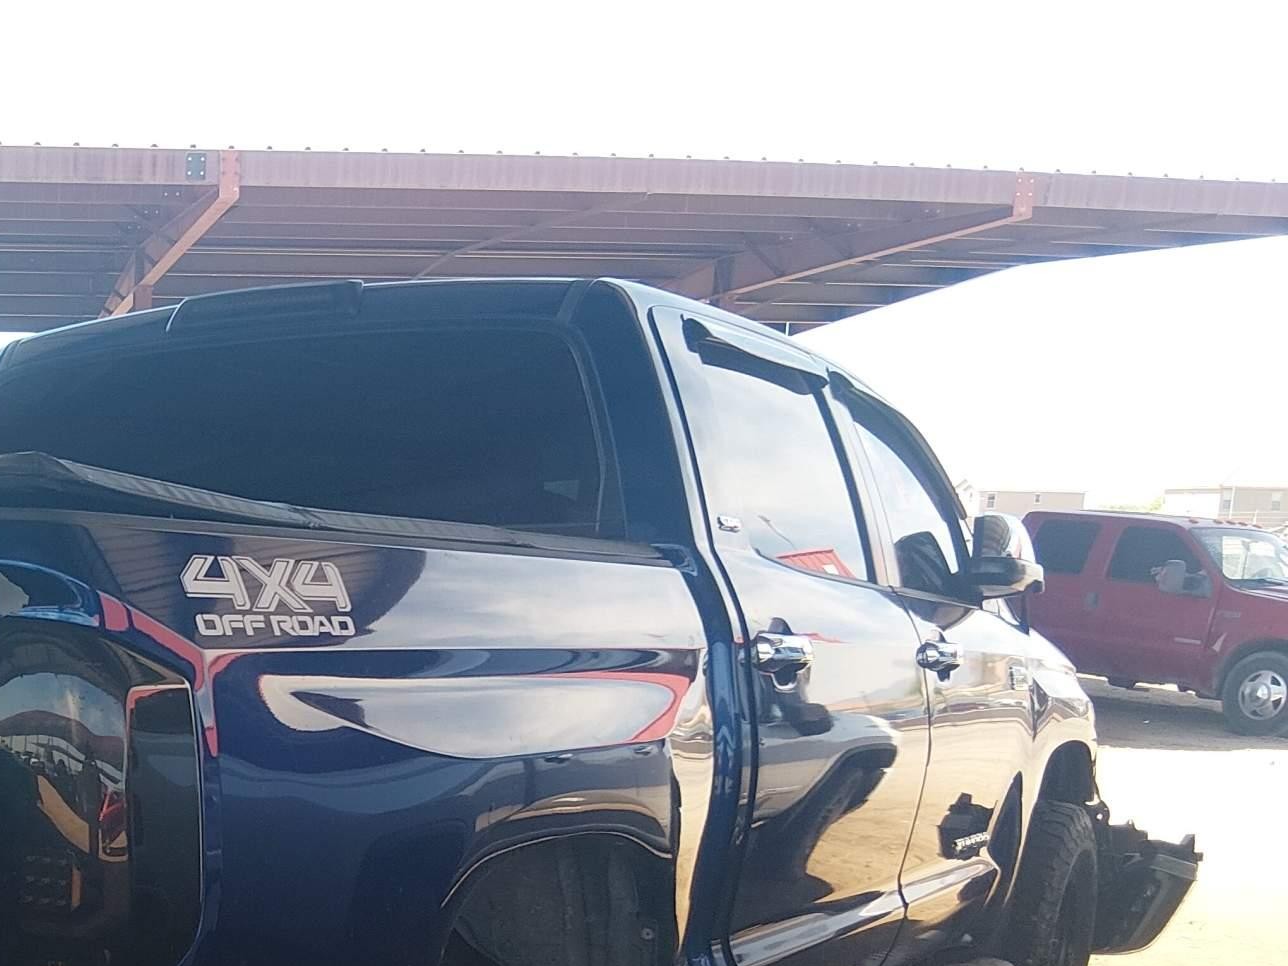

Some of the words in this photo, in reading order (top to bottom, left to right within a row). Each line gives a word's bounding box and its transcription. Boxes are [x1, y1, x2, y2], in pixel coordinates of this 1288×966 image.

[179, 554, 352, 612] 4X4
[195, 613, 265, 636] OFF
[269, 614, 356, 636] ROAD
